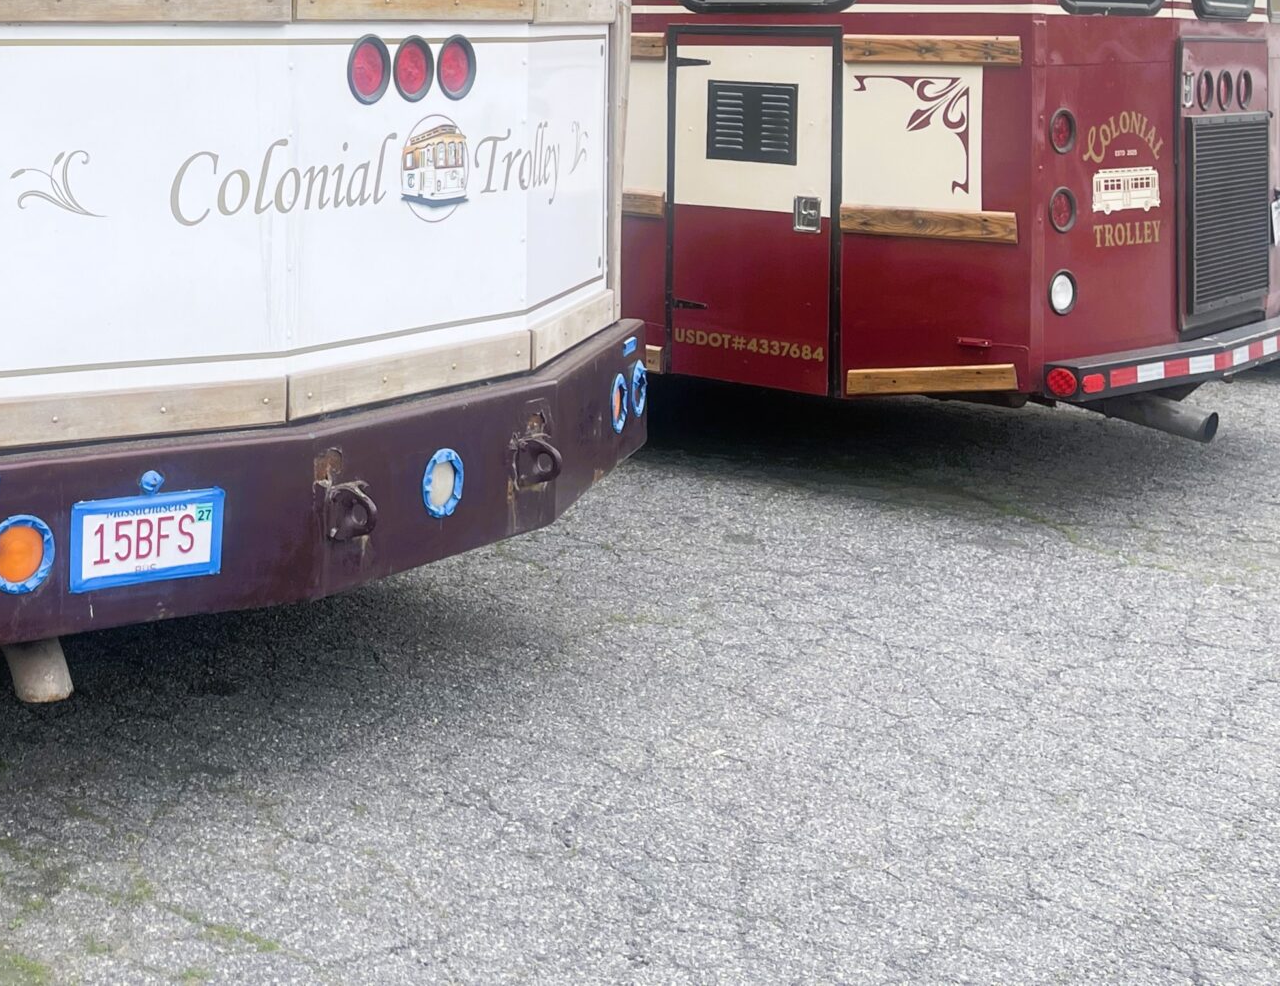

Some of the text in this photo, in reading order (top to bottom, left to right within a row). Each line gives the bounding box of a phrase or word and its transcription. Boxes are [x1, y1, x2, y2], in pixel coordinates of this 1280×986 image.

[1082, 110, 1164, 163] COLONIAL
[169, 120, 561, 227] Colonial Trolley
[1093, 220, 1161, 248] TROLLEY
[674, 327, 825, 362] USDOT#4337684
[197, 509, 212, 522] 27
[93, 513, 195, 566] 15BFS
